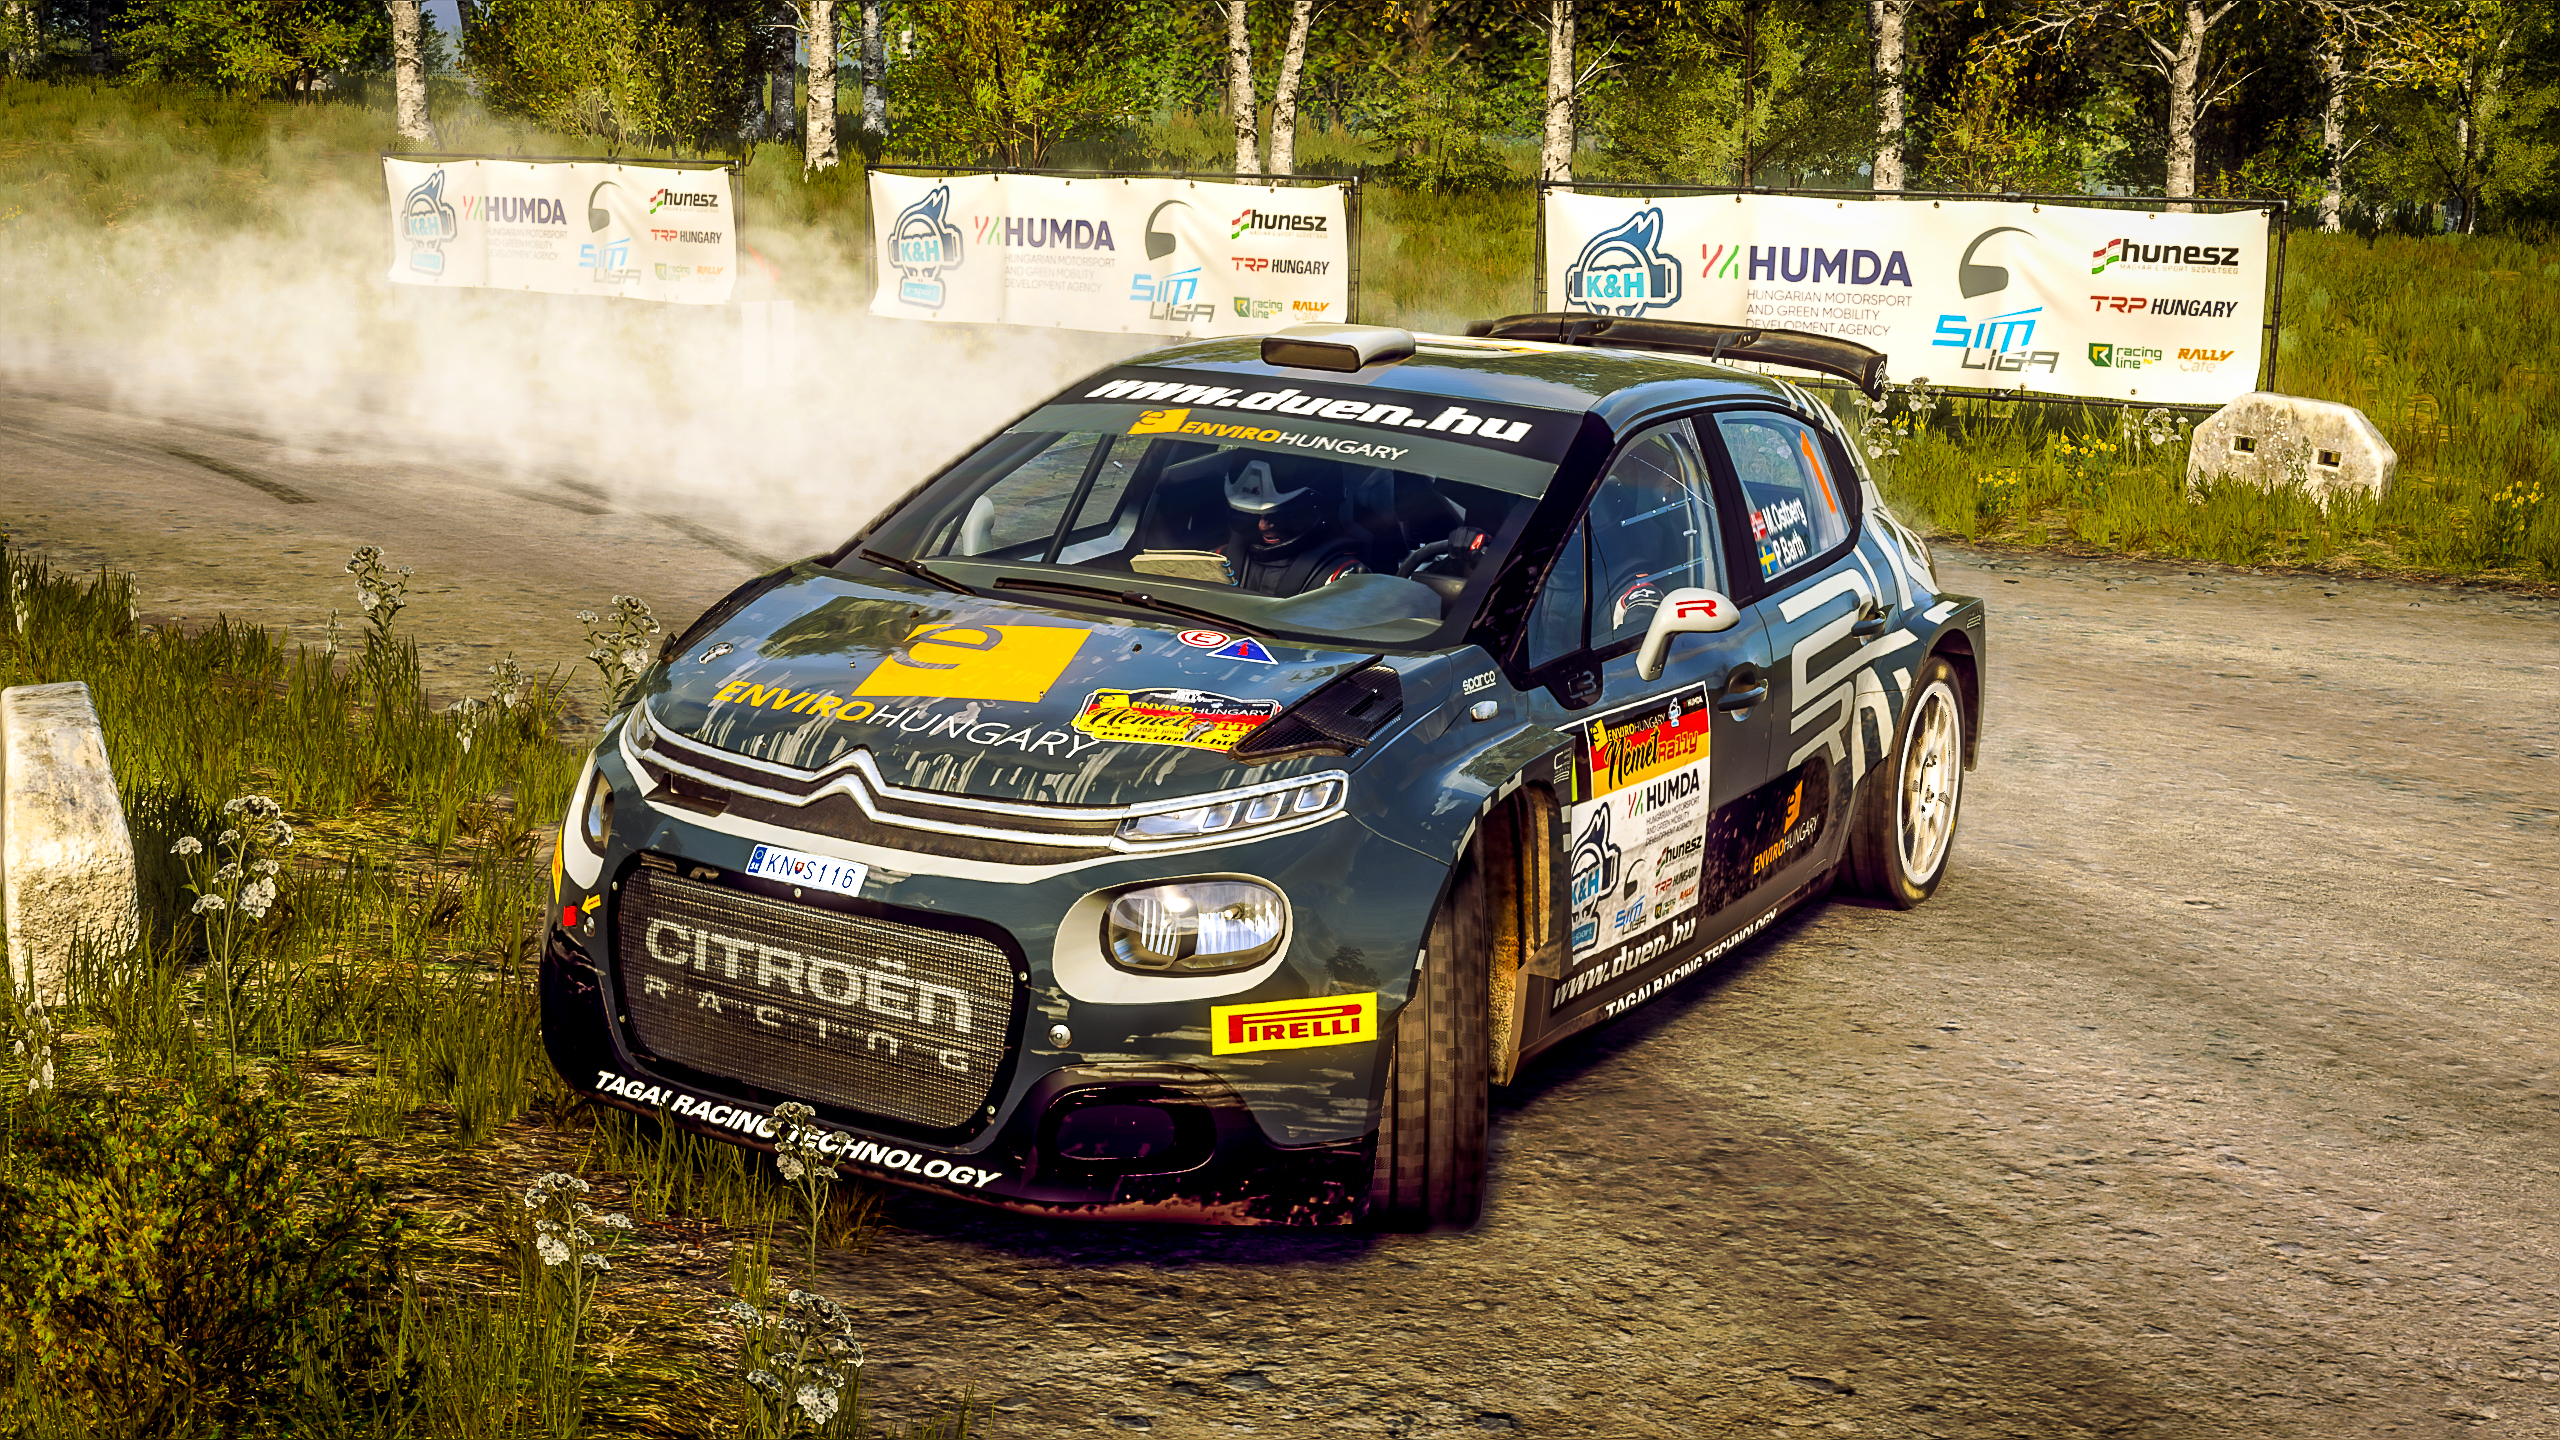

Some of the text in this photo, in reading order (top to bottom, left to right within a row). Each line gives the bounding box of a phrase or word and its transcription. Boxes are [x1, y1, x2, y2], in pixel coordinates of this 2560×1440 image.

[664, 189, 718, 207] hunesz
[485, 196, 567, 225] HUMDA
[1251, 209, 1327, 231] hunesz
[410, 215, 439, 236] K&H
[651, 229, 722, 244] TRP HUNGARY
[1005, 217, 1115, 251] HUMDA
[901, 240, 940, 262] K&H
[1005, 254, 1116, 268] HUNGARIAN MOTORSPORT
[2121, 238, 2239, 266] hunesz
[697, 265, 724, 275] RALLY
[1005, 266, 1094, 280] AND GREEN MOBILITY
[1231, 256, 1330, 275] TRP HUNGARY
[1749, 245, 1912, 287] HUMDA
[1005, 278, 1102, 293] DEVELOPMENT AGENCY
[1587, 272, 1644, 298] K&H
[1252, 299, 1282, 312] racing
[1292, 301, 1330, 312] RALLY
[1747, 289, 1912, 307] HUNGARIAN MOTORSPORT
[2090, 295, 2238, 318] TRP HUNGARY
[1252, 308, 1269, 319] line
[1746, 304, 1880, 320] AND GREEN MOBILITY
[1837, 323, 1891, 336] AGENCY
[2116, 346, 2162, 361] racing
[2116, 357, 2141, 369] line
[2177, 348, 2235, 362] RALLY
[1085, 378, 1533, 443] www.duen.hu
[1184, 420, 1408, 462] ENVIROHUNGARY
[1801, 430, 1837, 514] 1
[1676, 600, 1717, 618] R
[1462, 670, 1496, 693] sparco
[713, 680, 1099, 759] ENVIROHUNGARY
[1131, 701, 1269, 717] ENVIROHUNGARY
[1607, 713, 1665, 742] ENVIROHUNGARY
[1658, 730, 1698, 764] Rally
[1647, 768, 1700, 812] HUMDA
[1672, 796, 1699, 814] MOTORSPORT
[1665, 835, 1702, 863] hunesz
[1753, 814, 1819, 875] ENVIROHUNGARY
[1655, 877, 1672, 896] TRP
[1552, 917, 1697, 1010] www.duen.hu
[1653, 957, 1702, 993] RACING
[643, 974, 970, 1074] RACING
[1228, 1004, 1362, 1044] PIRELLI
